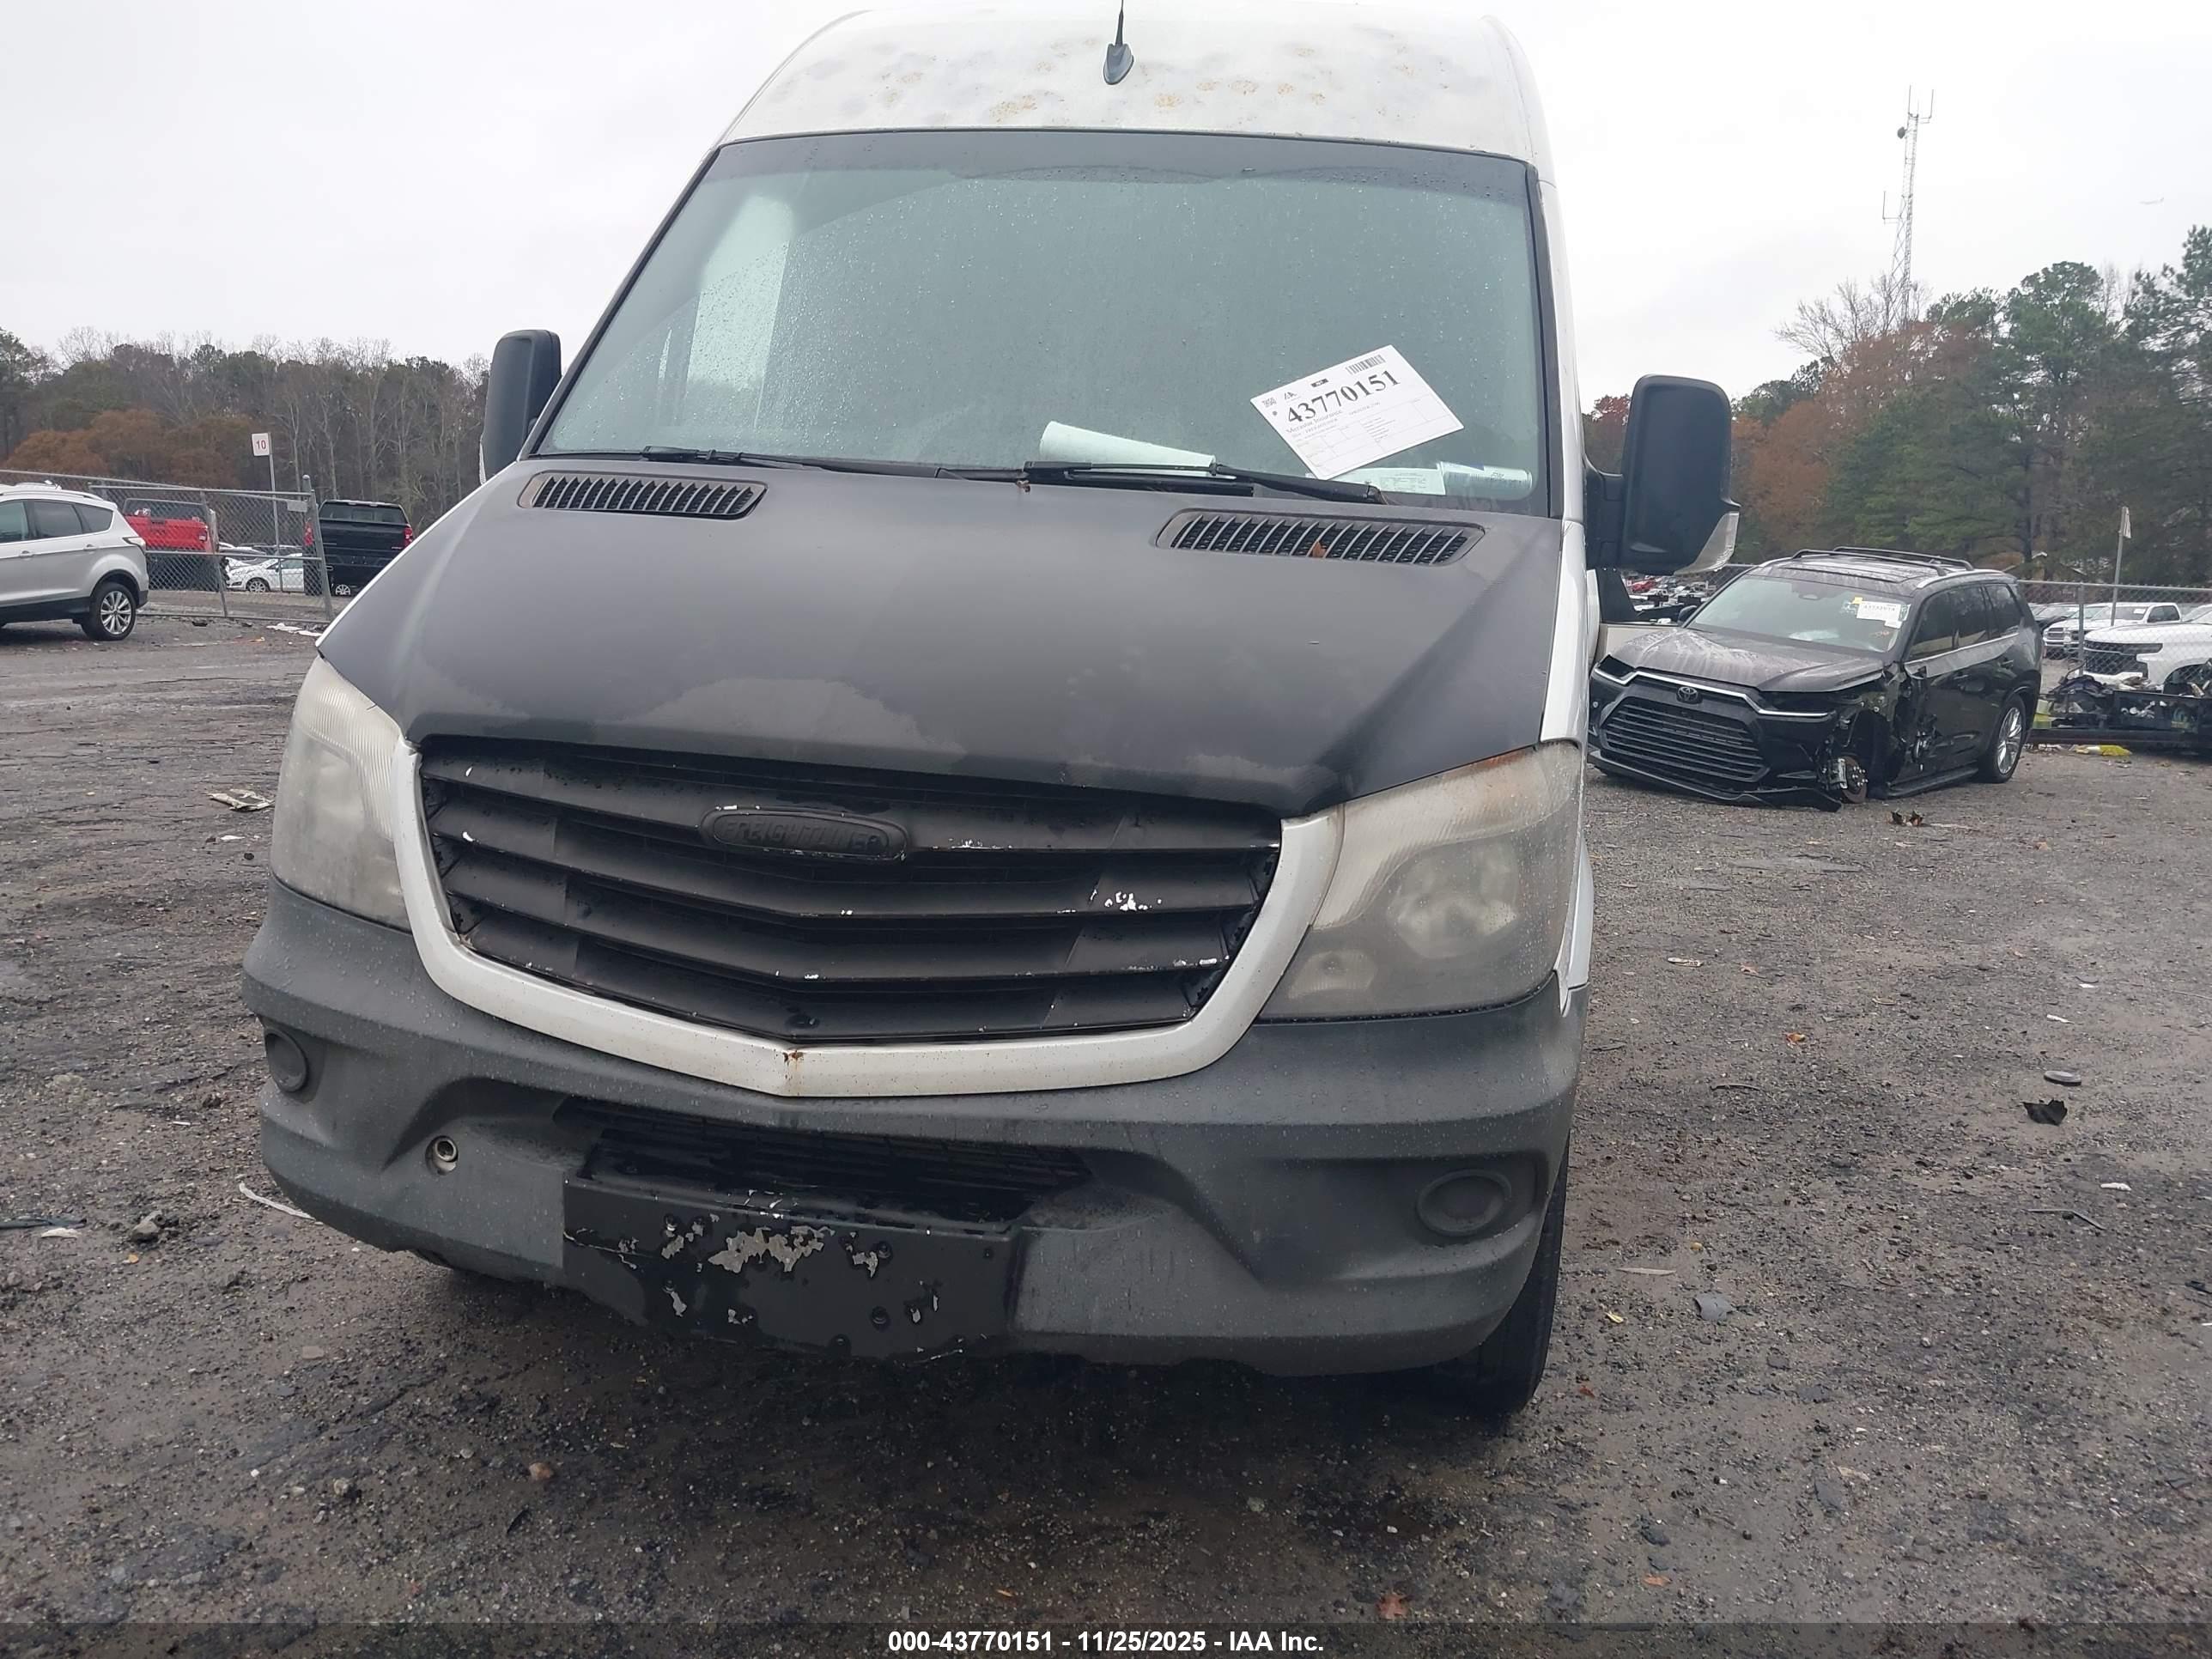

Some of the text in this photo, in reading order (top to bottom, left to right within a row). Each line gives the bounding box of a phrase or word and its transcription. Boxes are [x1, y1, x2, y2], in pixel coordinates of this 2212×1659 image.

[1288, 370, 1401, 422] 43770151
[256, 440, 266, 450] 10
[723, 820, 882, 850] FREIGHTLINER
